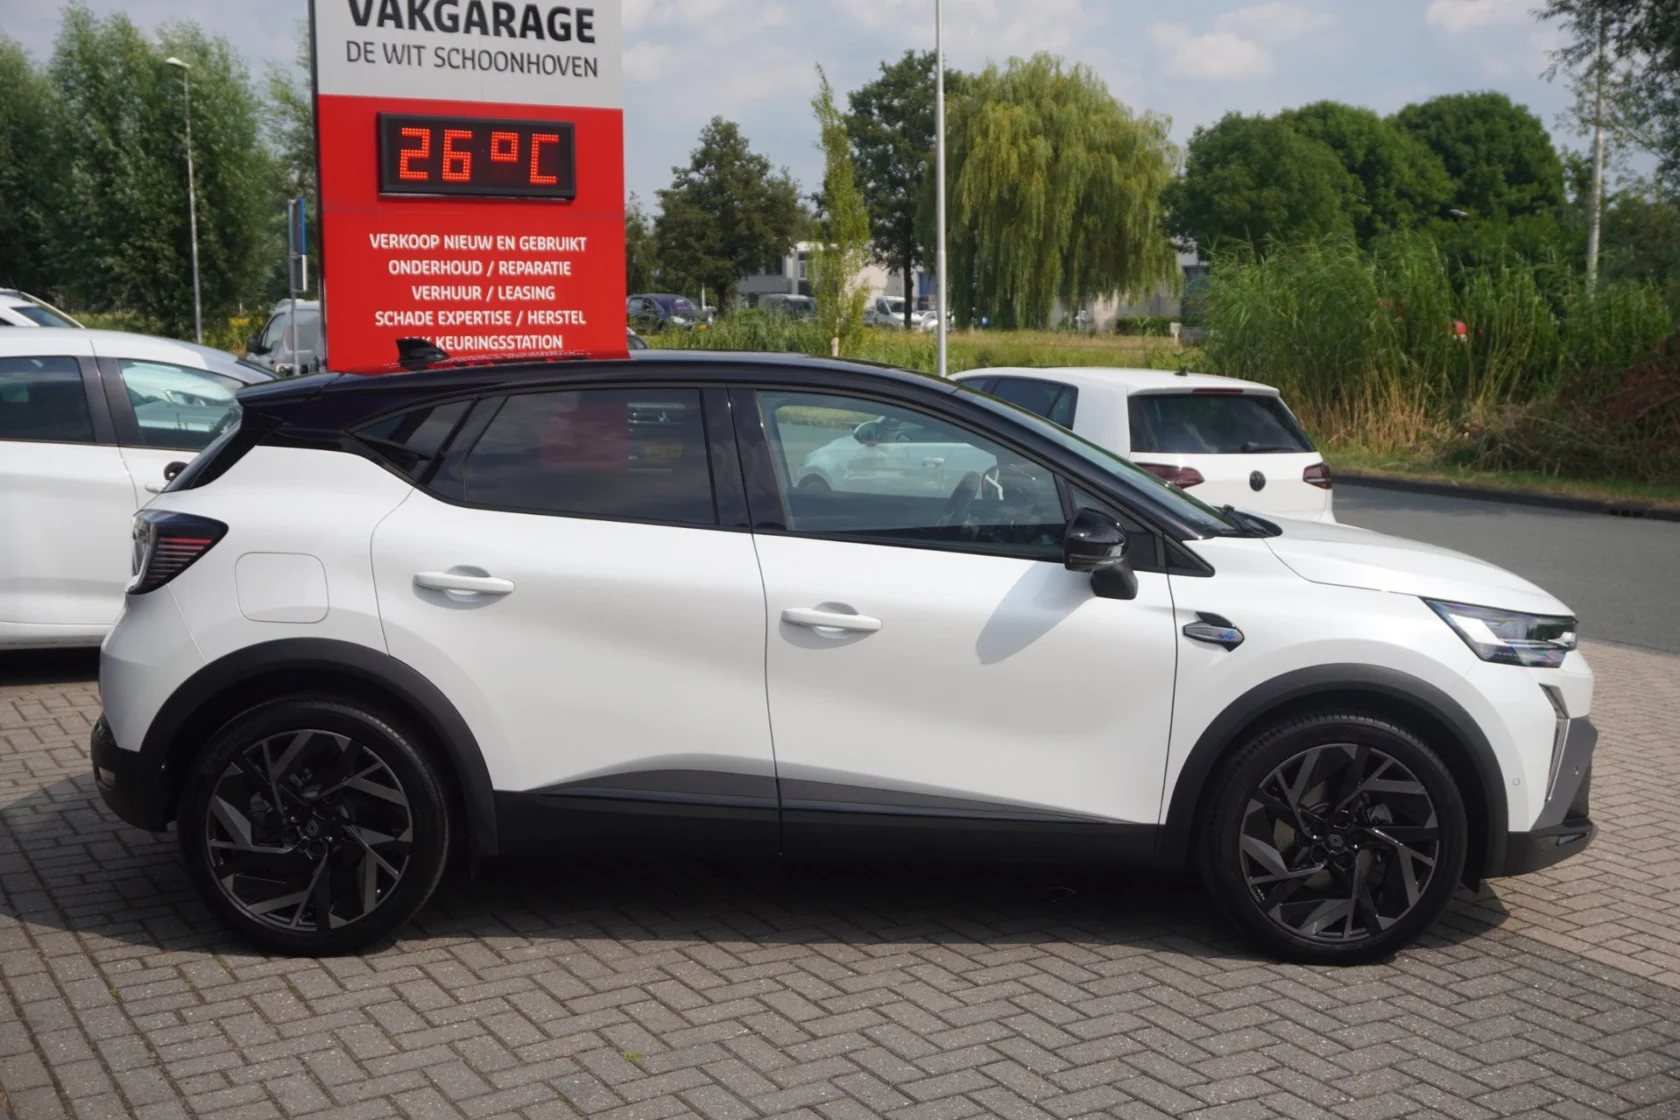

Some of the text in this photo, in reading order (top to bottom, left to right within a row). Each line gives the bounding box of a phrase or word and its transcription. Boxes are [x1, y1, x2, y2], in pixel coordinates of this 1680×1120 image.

[347, 0, 596, 43] VAKGARAGE
[346, 40, 599, 78] DE WIT SCHOONHOVEN
[369, 233, 588, 252] VERKOOP NIEUW EN GEBRUIKT
[388, 259, 571, 277] ONDERHOUD / REPARATIE
[411, 285, 556, 302] VERHUUR / LEASING
[375, 310, 587, 327] SCHADE EXPERTISE / HERSTEL
[435, 335, 563, 350] KEURINGSSTATION
